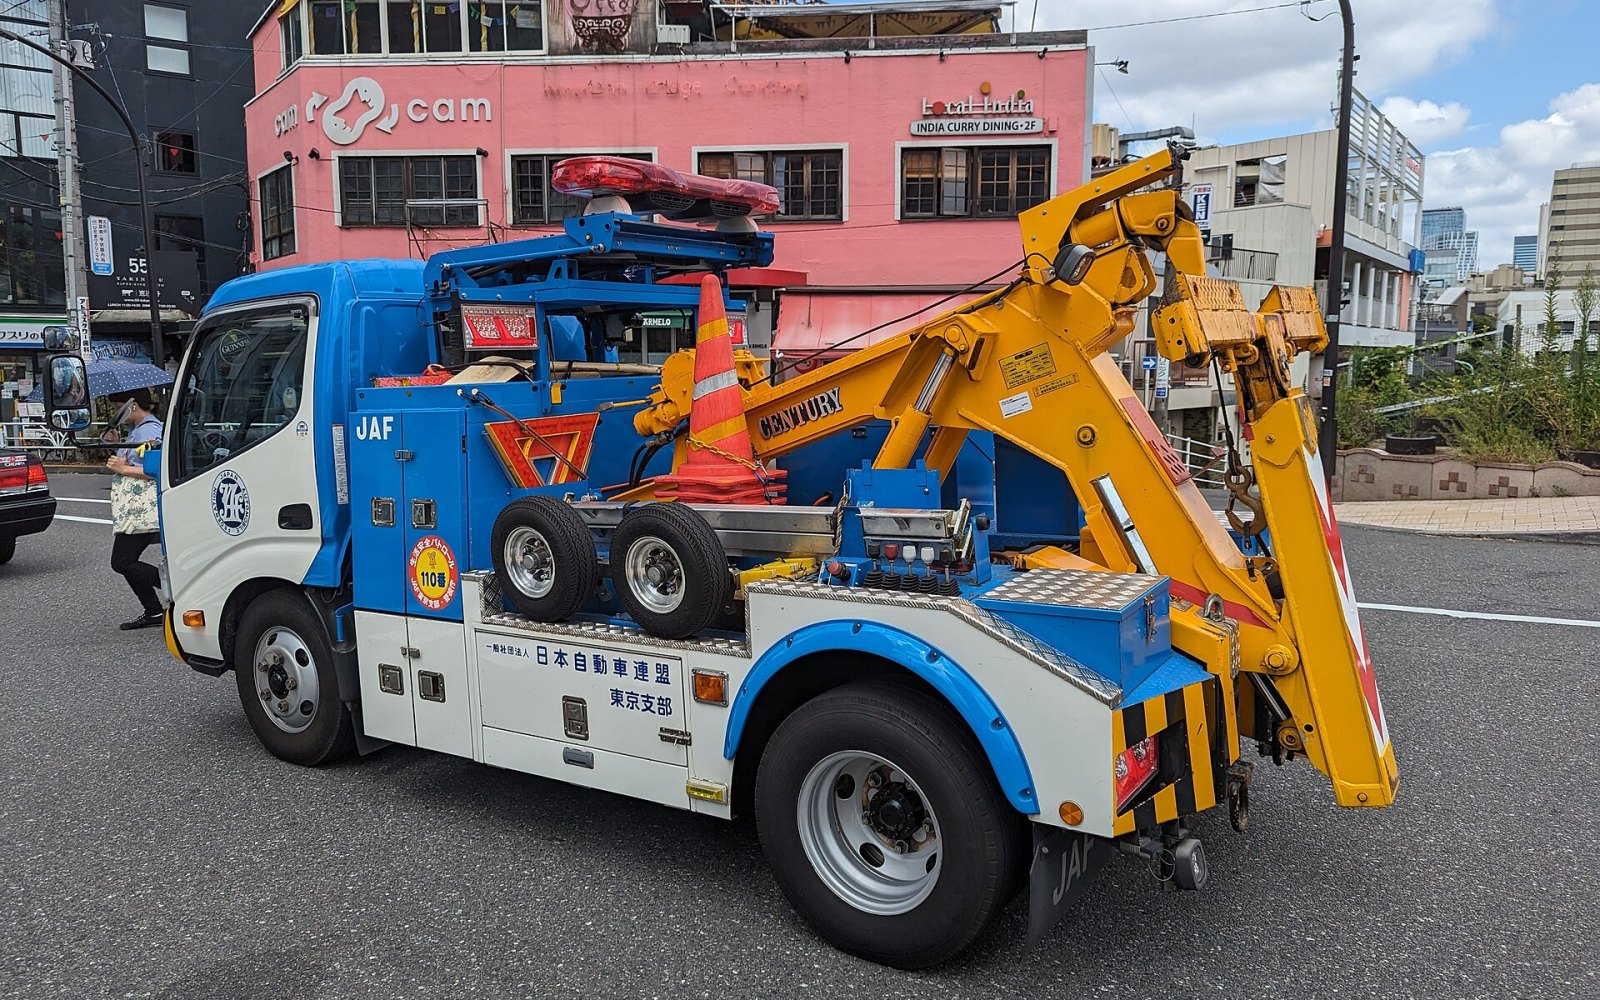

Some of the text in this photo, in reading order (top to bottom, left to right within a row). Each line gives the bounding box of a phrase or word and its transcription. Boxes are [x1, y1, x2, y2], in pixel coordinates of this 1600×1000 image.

[275, 104, 298, 137] cam
[407, 98, 492, 122] cam
[917, 123, 944, 132] INDIA
[947, 122, 980, 132] CURRY
[1196, 194, 1206, 220] KEN
[129, 258, 148, 274] 55
[758, 387, 843, 439] CENTURY
[356, 416, 394, 440] JAF
[219, 471, 239, 480] JAPAN
[410, 537, 456, 569] 生活安全パトロール
[420, 571, 446, 588] 110番
[485, 643, 672, 686] 一般社団法人 日本自動車連盟
[609, 687, 673, 717] 東京支部
